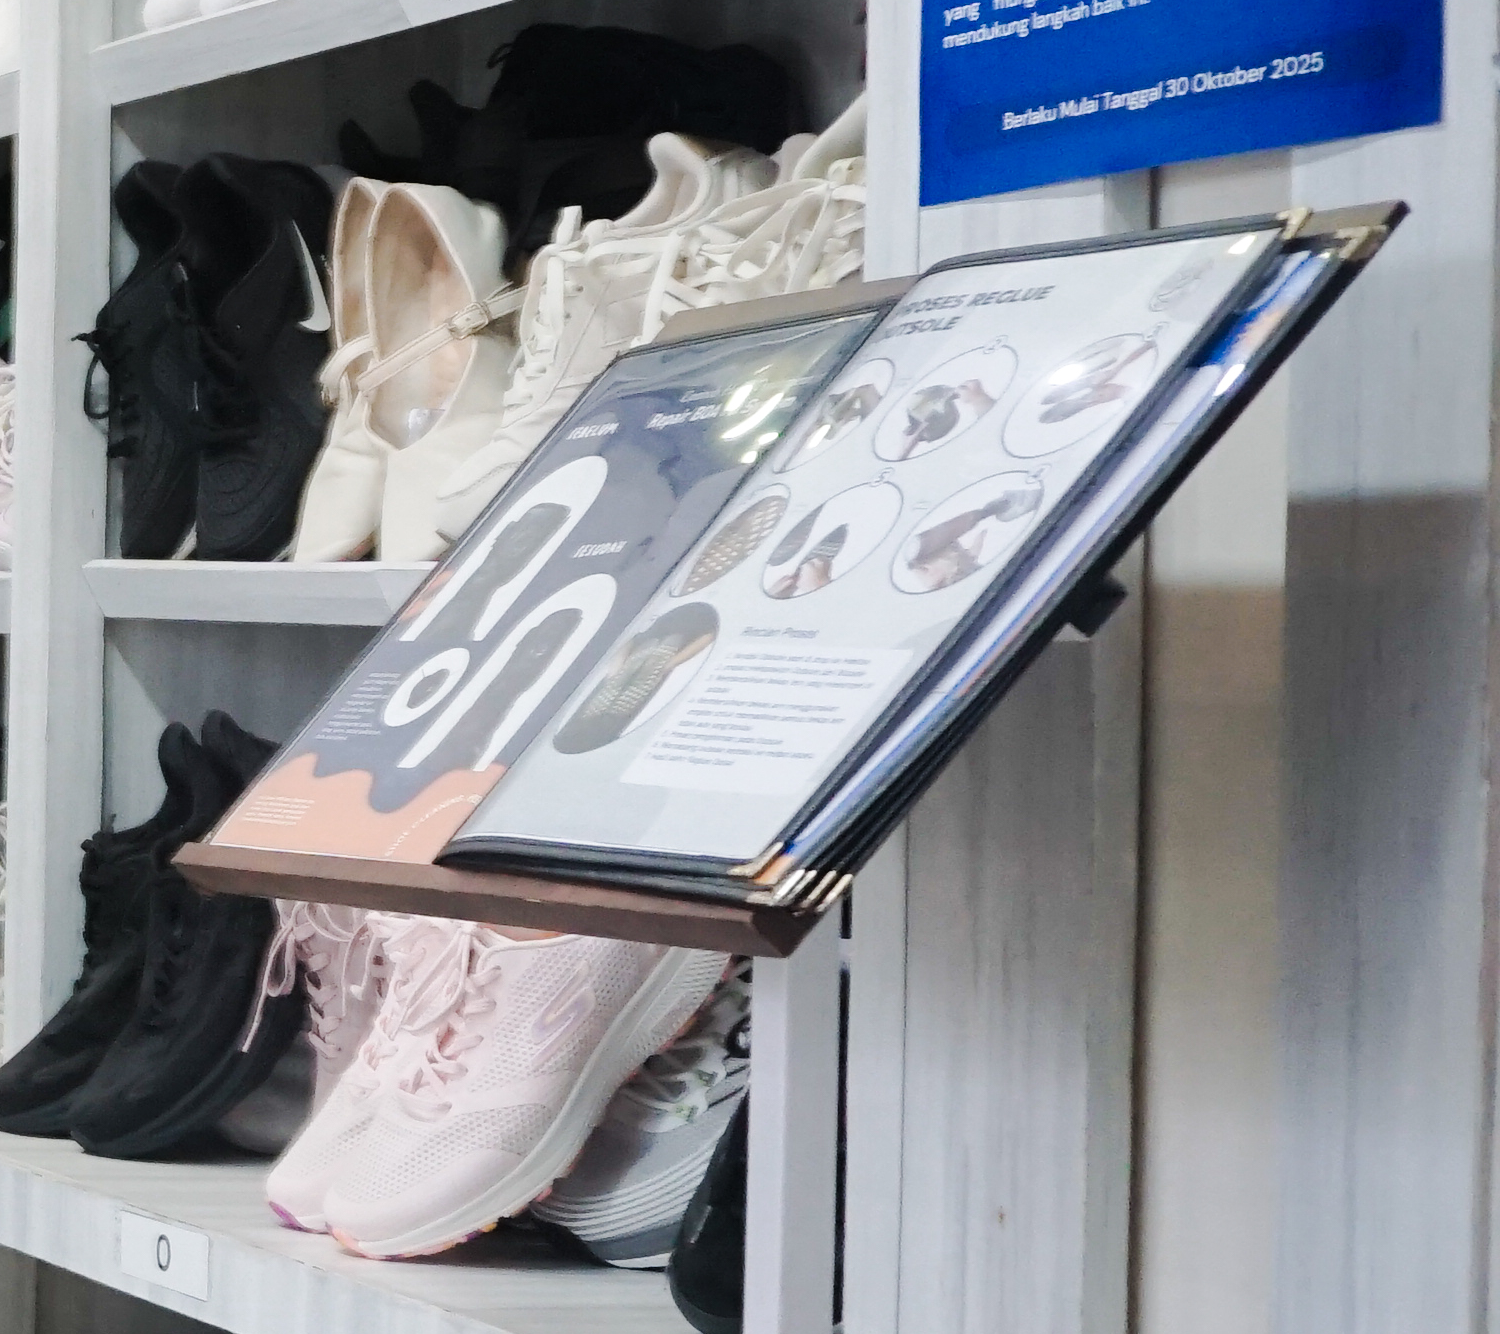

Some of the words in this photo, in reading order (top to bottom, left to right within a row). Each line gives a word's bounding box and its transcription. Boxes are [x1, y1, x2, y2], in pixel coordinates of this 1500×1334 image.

[942, 18, 1030, 49] mendukung
[1031, 1, 1090, 30] langkah
[944, 2, 981, 26] yang
[1002, 105, 1057, 131] Berlaku
[1058, 94, 1099, 118] Mulai
[1101, 82, 1162, 111] Tanggal
[1164, 76, 1189, 98] 30
[1190, 66, 1267, 94] Oktober
[1269, 51, 1324, 81] 2025
